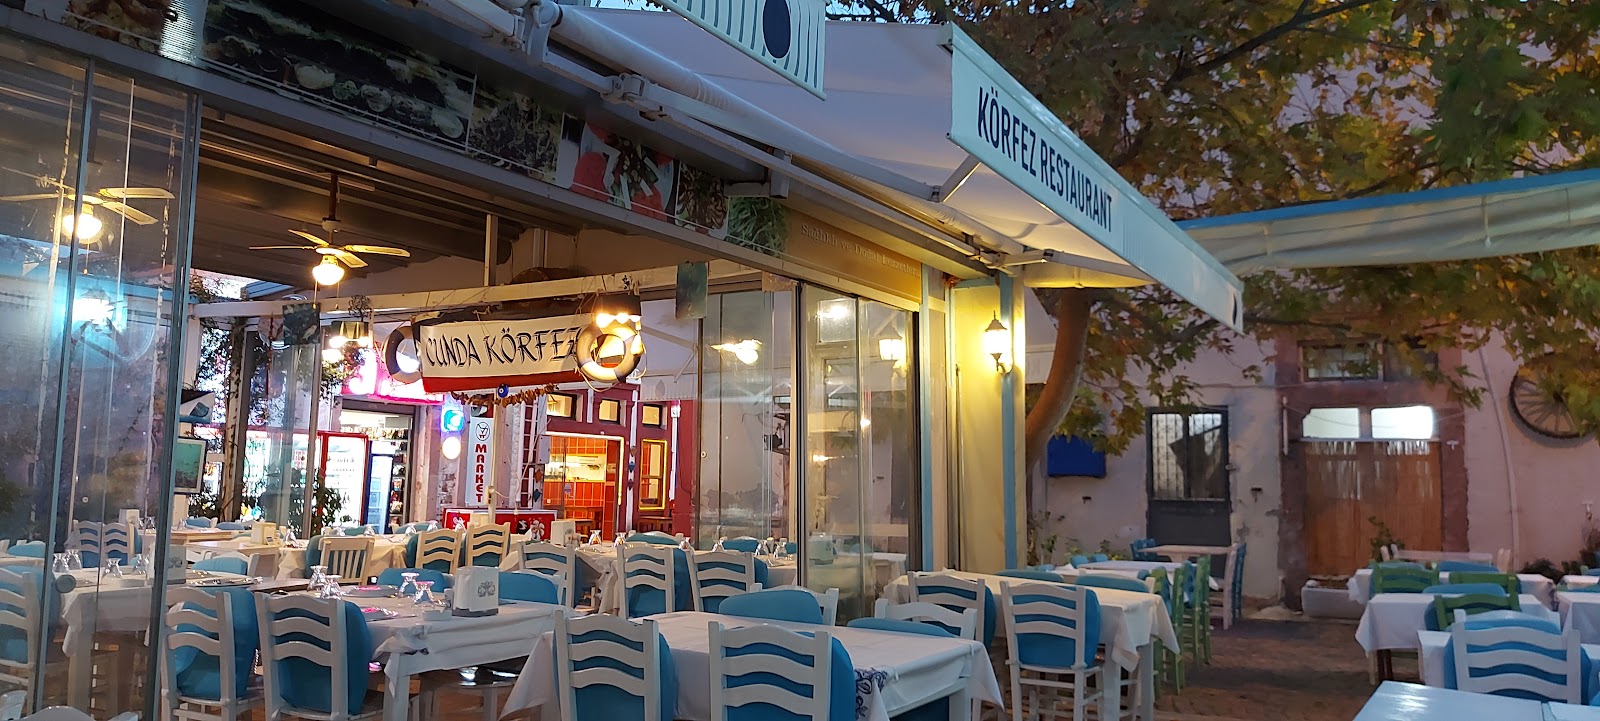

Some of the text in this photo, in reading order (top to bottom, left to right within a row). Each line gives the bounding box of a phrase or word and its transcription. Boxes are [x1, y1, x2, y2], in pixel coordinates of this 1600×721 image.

[977, 86, 1113, 232] KÖRFEZ RESTAURANT
[841, 241, 852, 251] ve
[426, 334, 482, 368] CUNDA
[475, 443, 487, 503] MARKET
